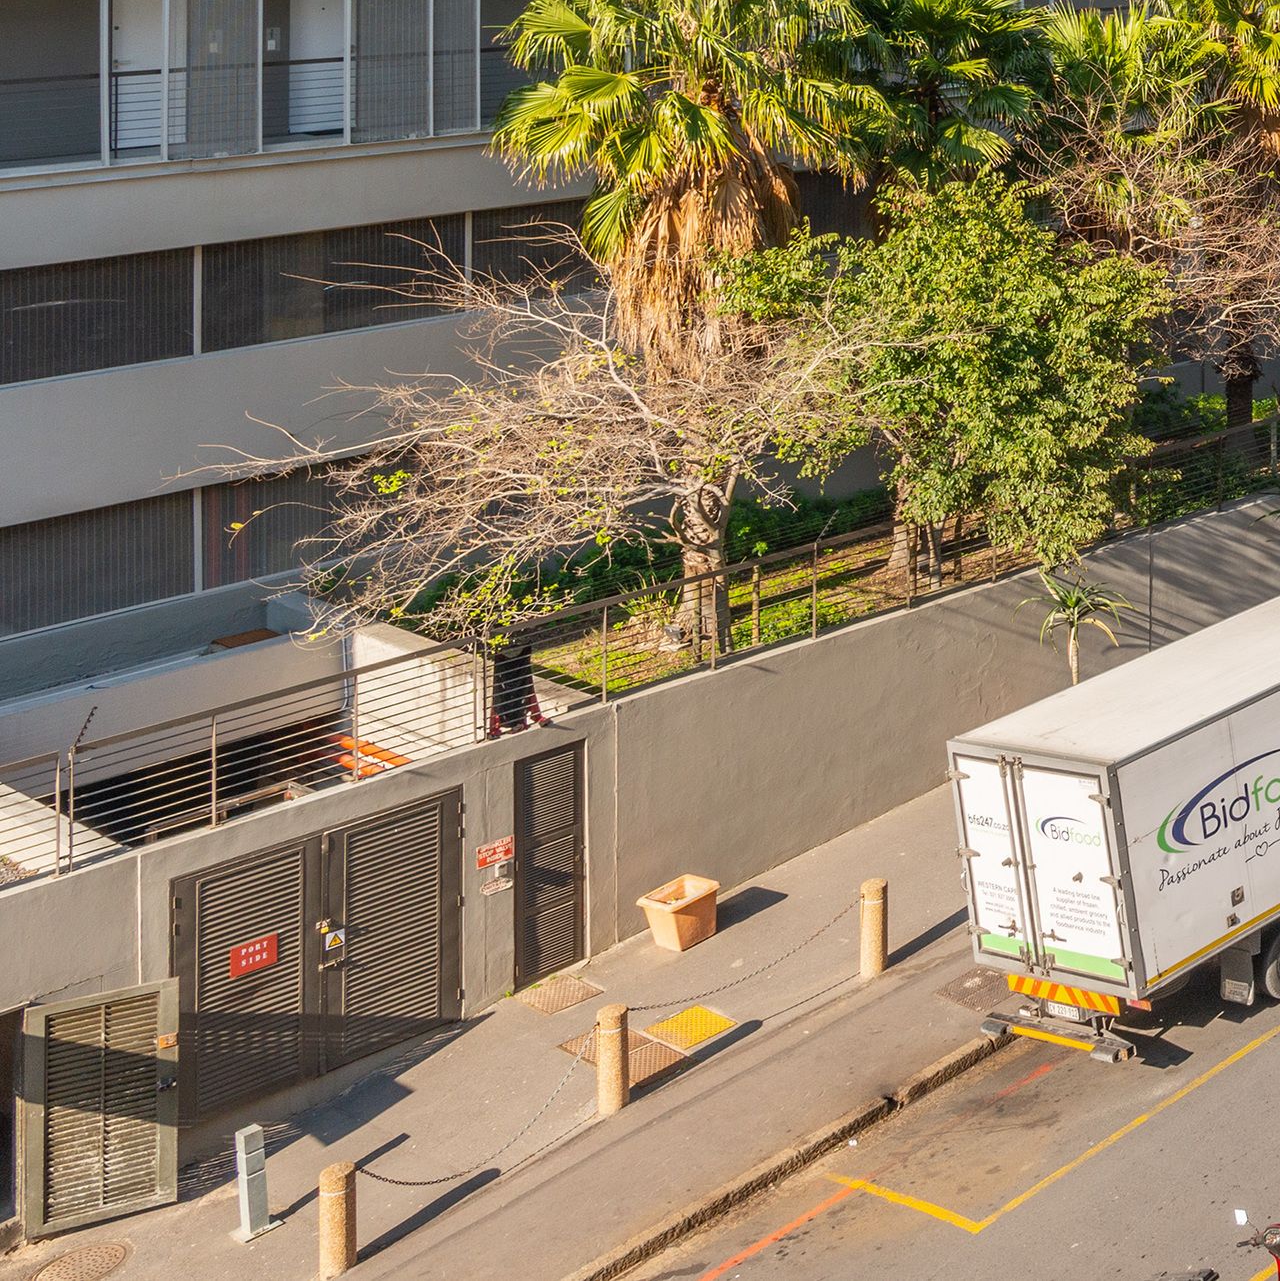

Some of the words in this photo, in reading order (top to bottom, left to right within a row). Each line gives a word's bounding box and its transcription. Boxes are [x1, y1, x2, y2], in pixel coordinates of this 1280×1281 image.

[1050, 823, 1101, 847] Bidfood
[1158, 845, 1231, 891] Passionate
[1234, 823, 1271, 850] about
[240, 940, 269, 956] PORT
[240, 951, 269, 968] SIDE
